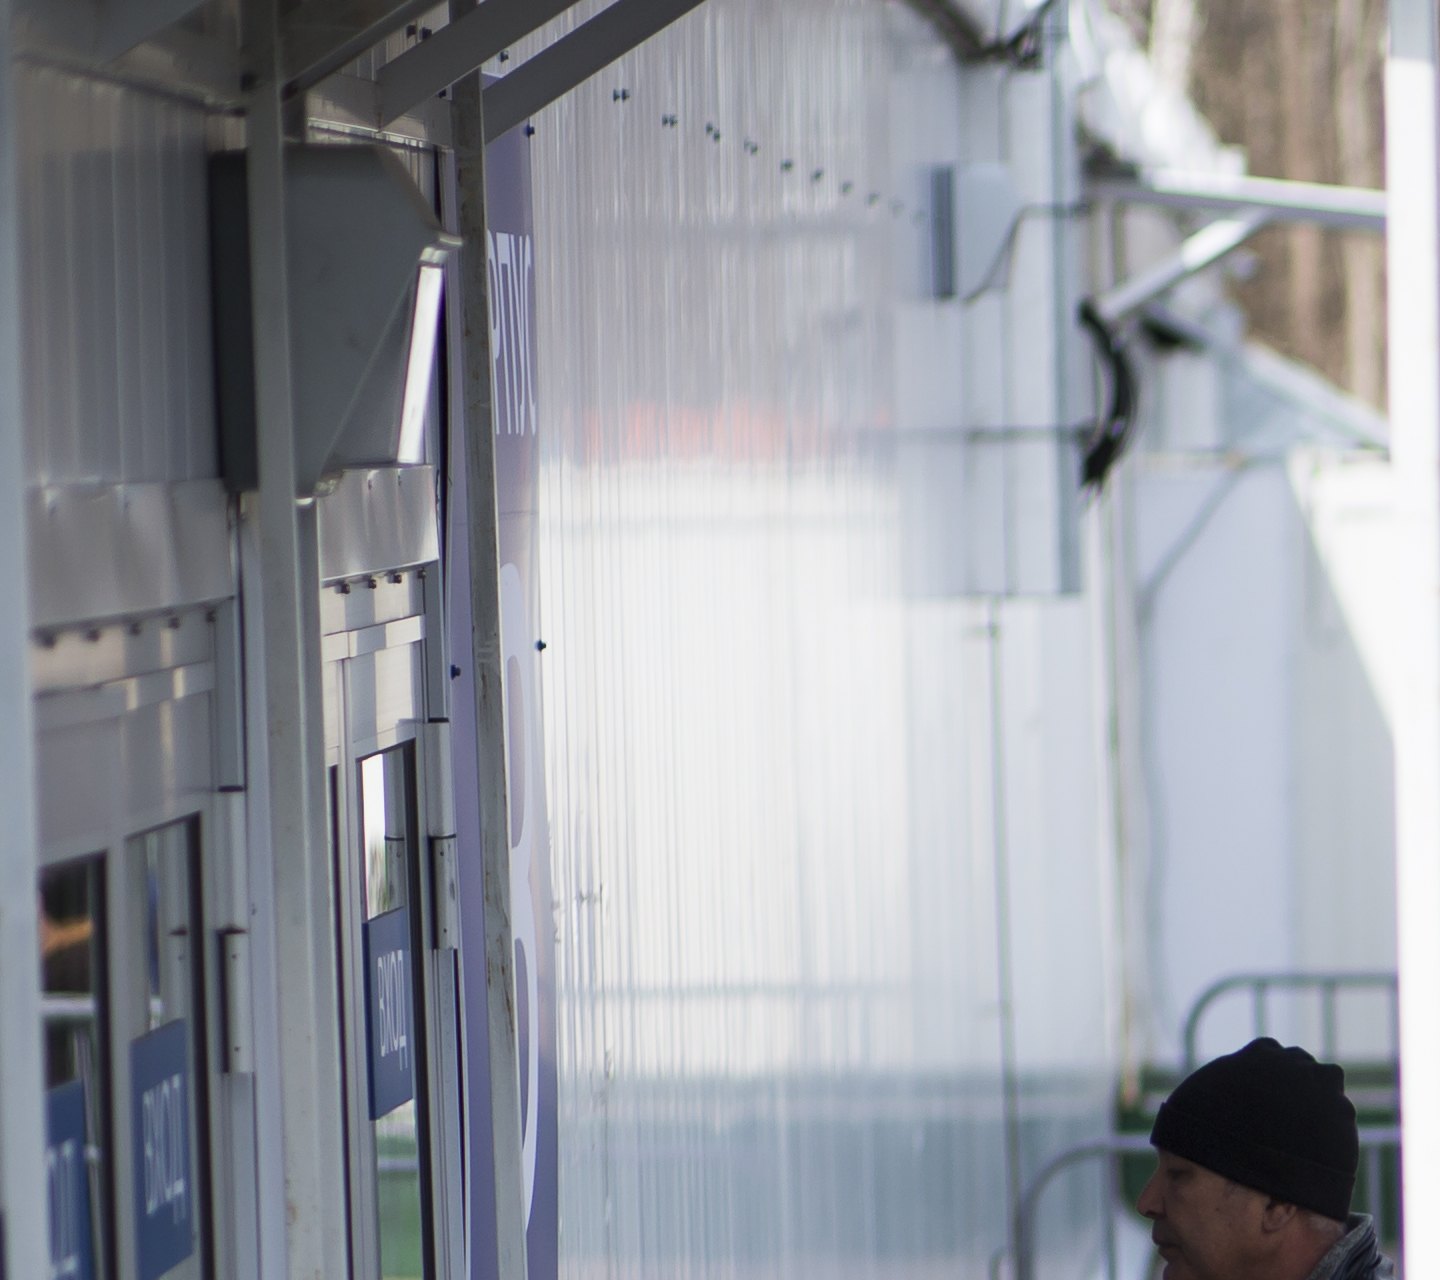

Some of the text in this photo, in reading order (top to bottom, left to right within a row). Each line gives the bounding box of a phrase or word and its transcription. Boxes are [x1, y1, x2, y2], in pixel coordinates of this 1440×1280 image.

[487, 229, 537, 437] РПУС
[377, 948, 409, 1072] ВХОД
[142, 1072, 187, 1226] ВХОД
